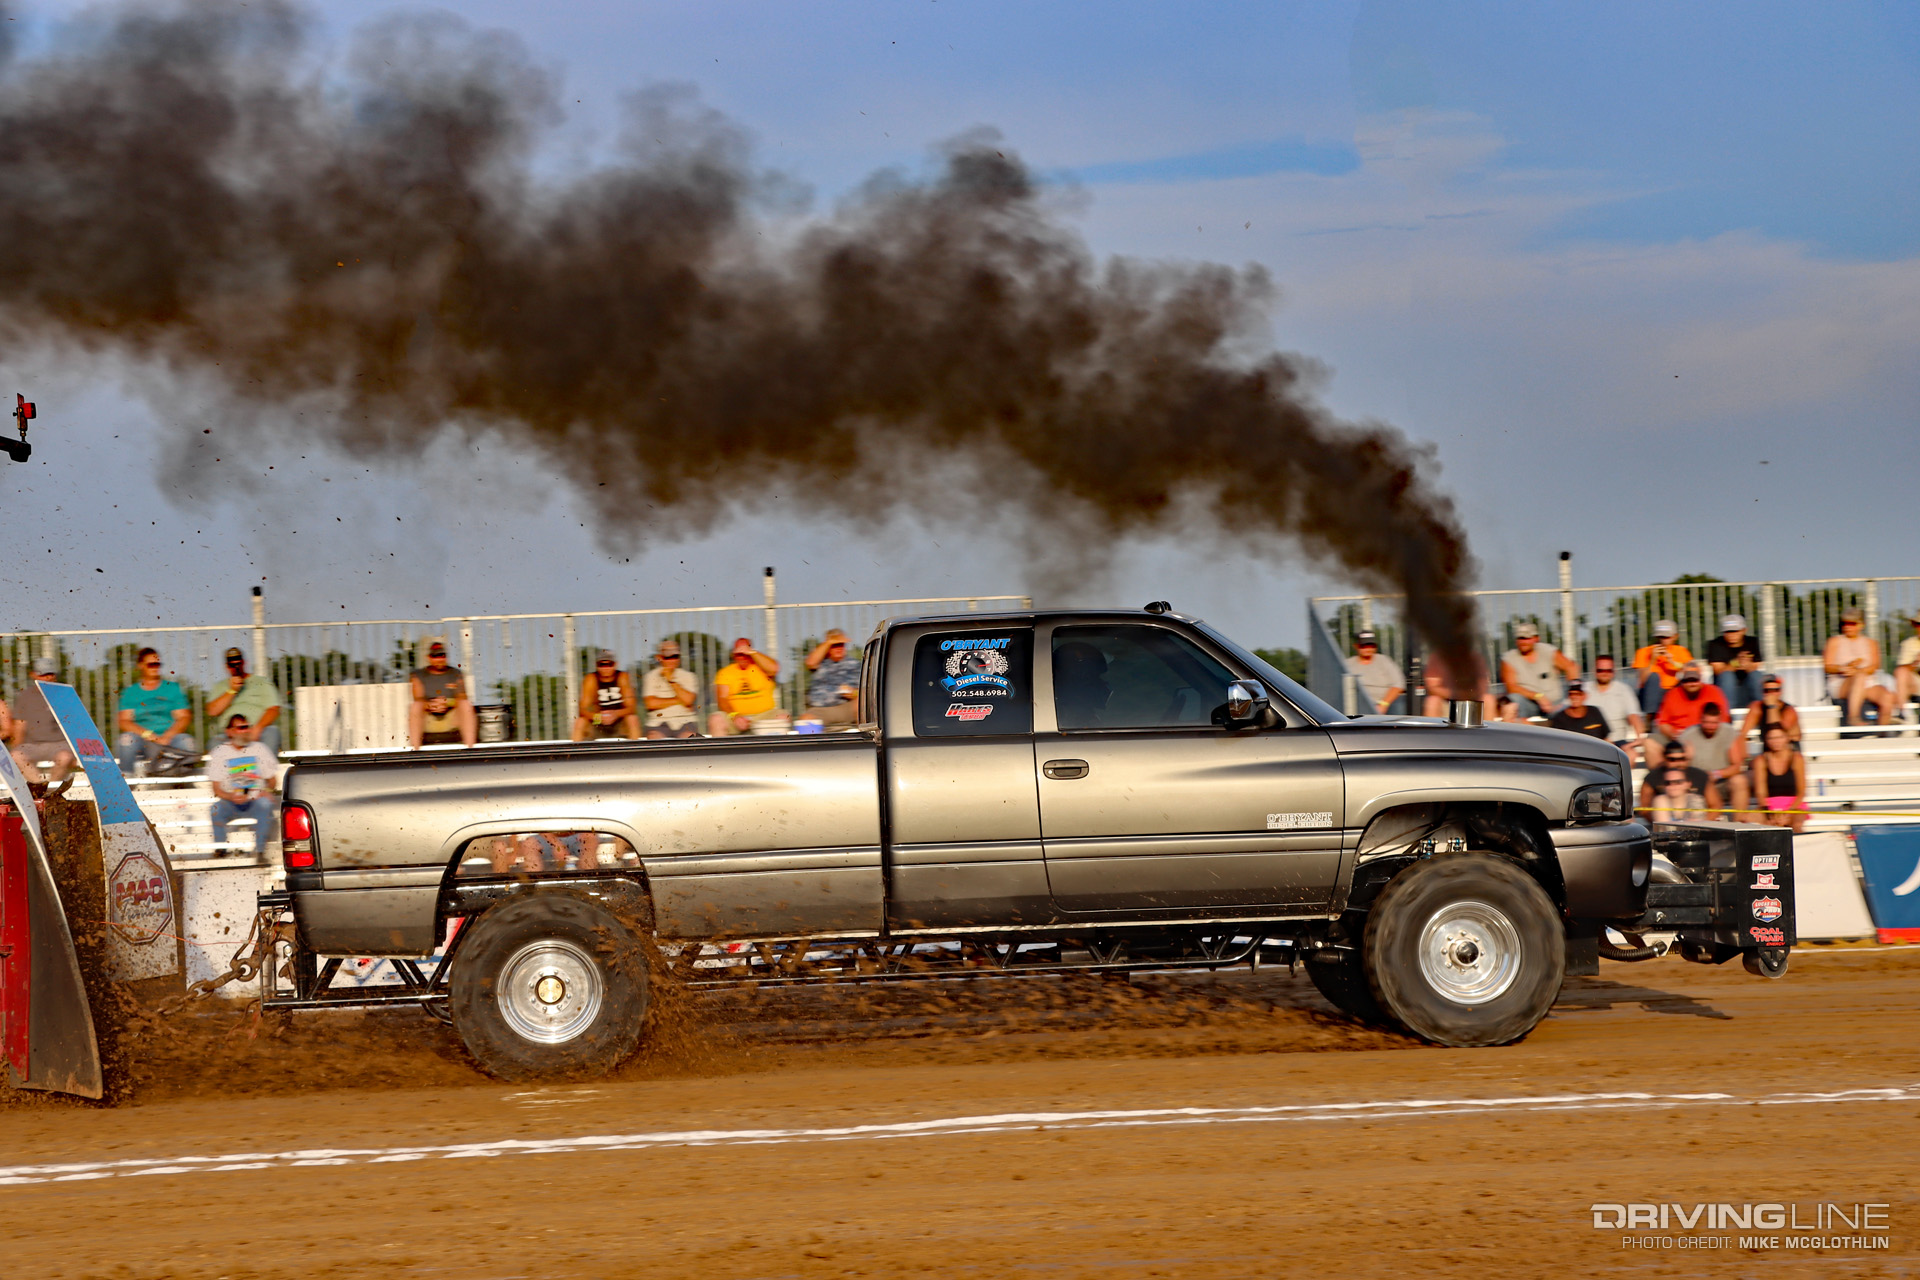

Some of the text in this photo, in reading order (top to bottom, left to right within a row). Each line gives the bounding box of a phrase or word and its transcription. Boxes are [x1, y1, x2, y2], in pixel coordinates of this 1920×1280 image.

[940, 638, 1011, 651] O'BRYANT
[956, 675, 1008, 687] Diesel Service
[951, 689, 1007, 698] 502.548.6984
[1754, 856, 1778, 864] OPTIMA
[1750, 927, 1784, 935] COAL
[1753, 934, 1784, 942] TRAIN
